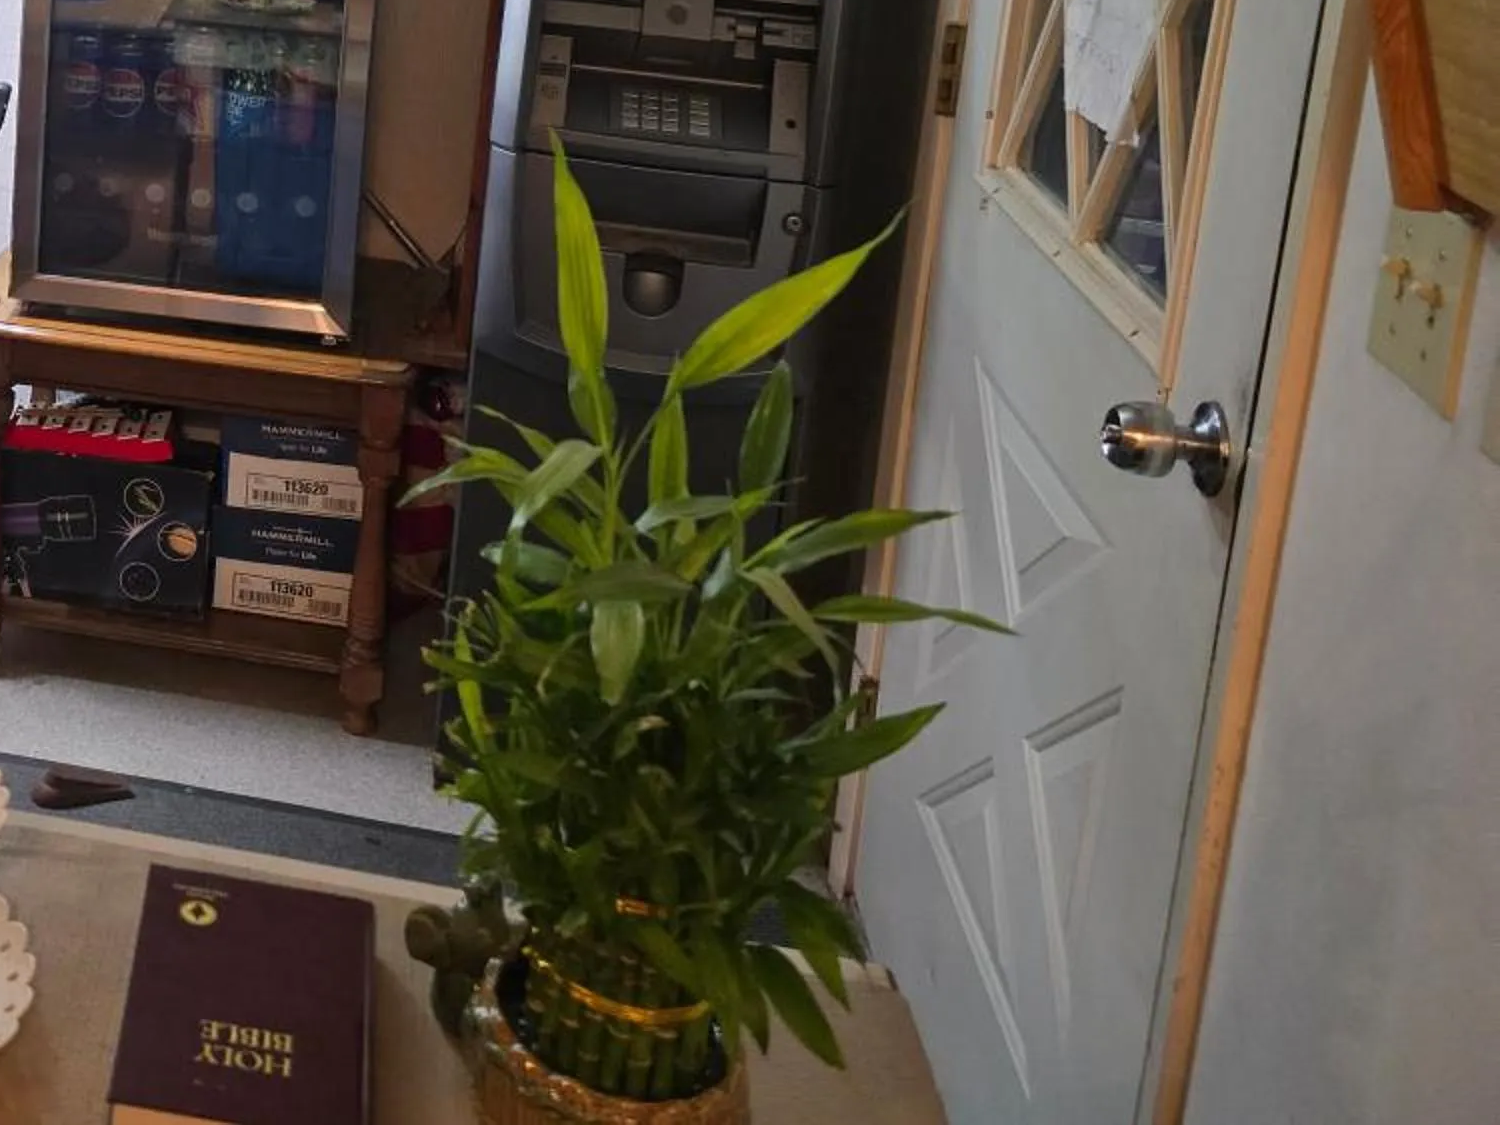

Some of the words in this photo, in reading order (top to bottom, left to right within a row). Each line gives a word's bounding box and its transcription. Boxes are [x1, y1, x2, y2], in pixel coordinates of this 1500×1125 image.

[284, 479, 329, 496] 113620
[251, 529, 330, 547] HAMMERMILL
[271, 580, 314, 598] 113620
[199, 1018, 293, 1054] BIBLE
[194, 1041, 292, 1078] HOLY
